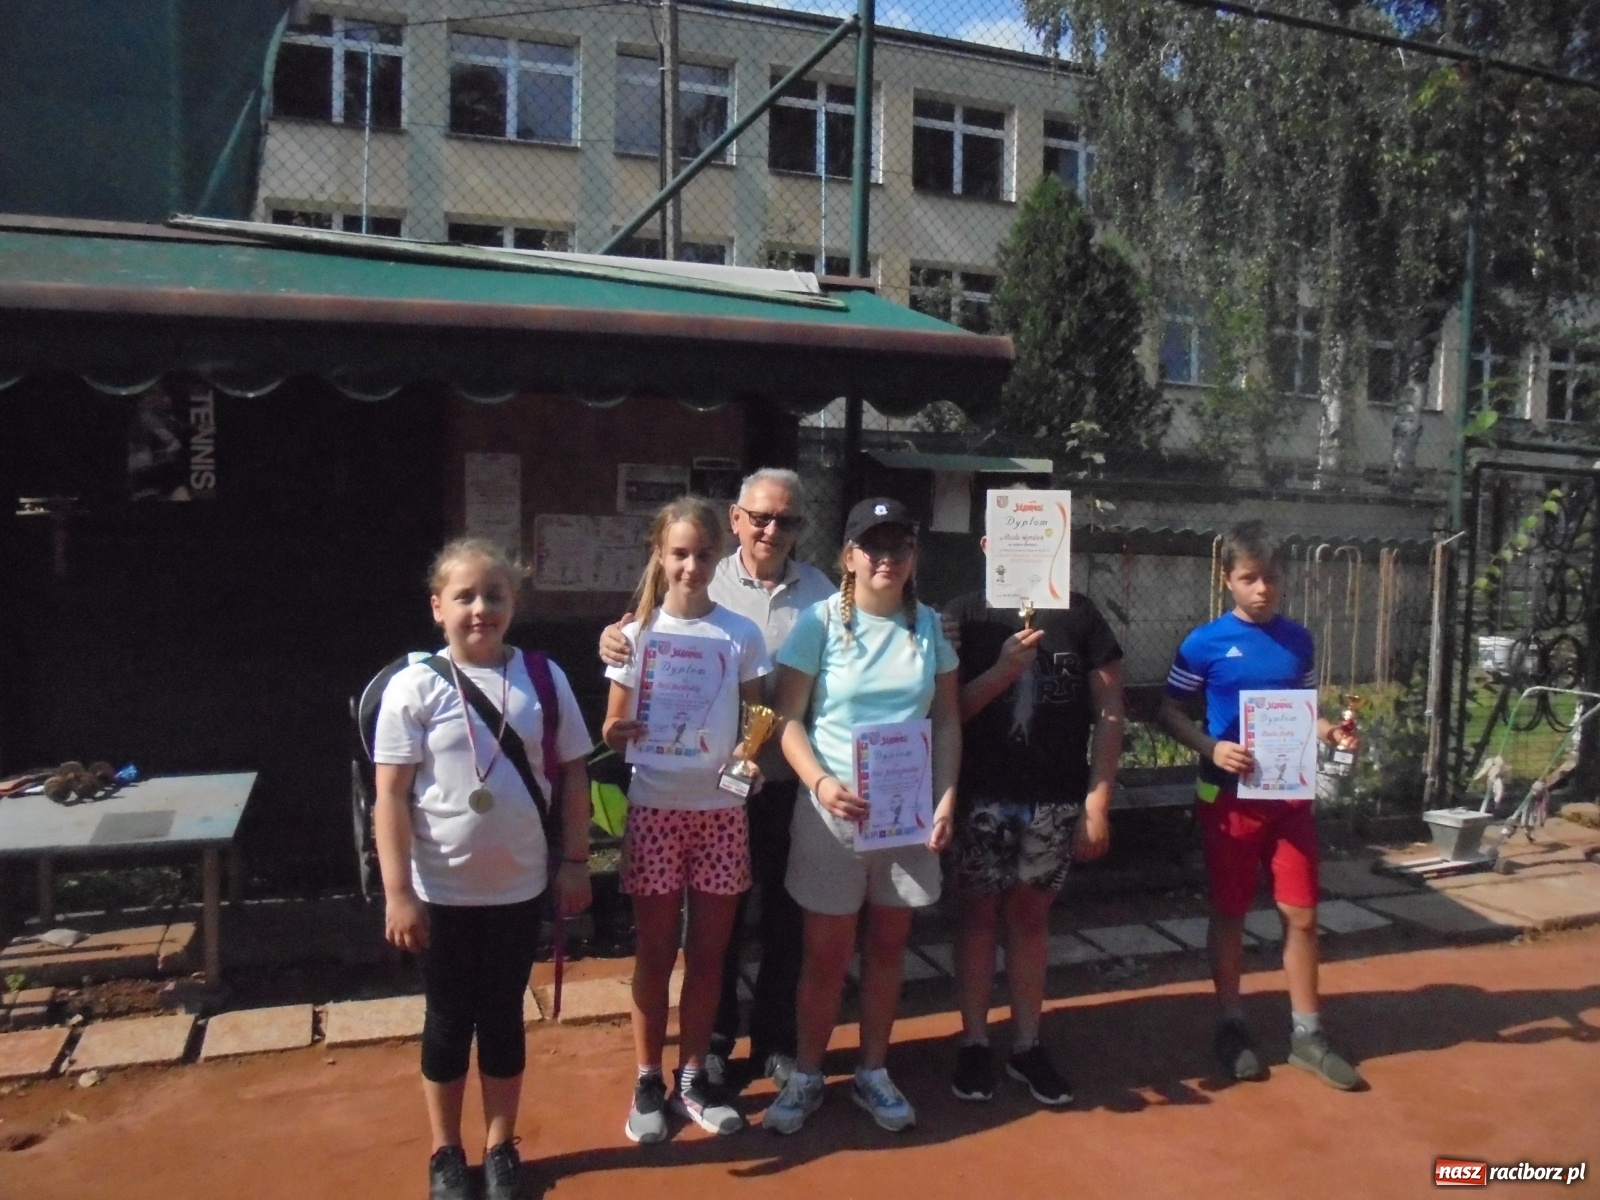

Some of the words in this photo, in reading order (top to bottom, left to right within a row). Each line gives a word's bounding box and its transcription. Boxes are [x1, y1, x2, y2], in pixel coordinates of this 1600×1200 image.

[189, 390, 216, 490] TENNIS
[1005, 515, 1048, 530] Dyplom
[660, 661, 707, 677] Dyplom
[1258, 713, 1298, 725] Dyplom
